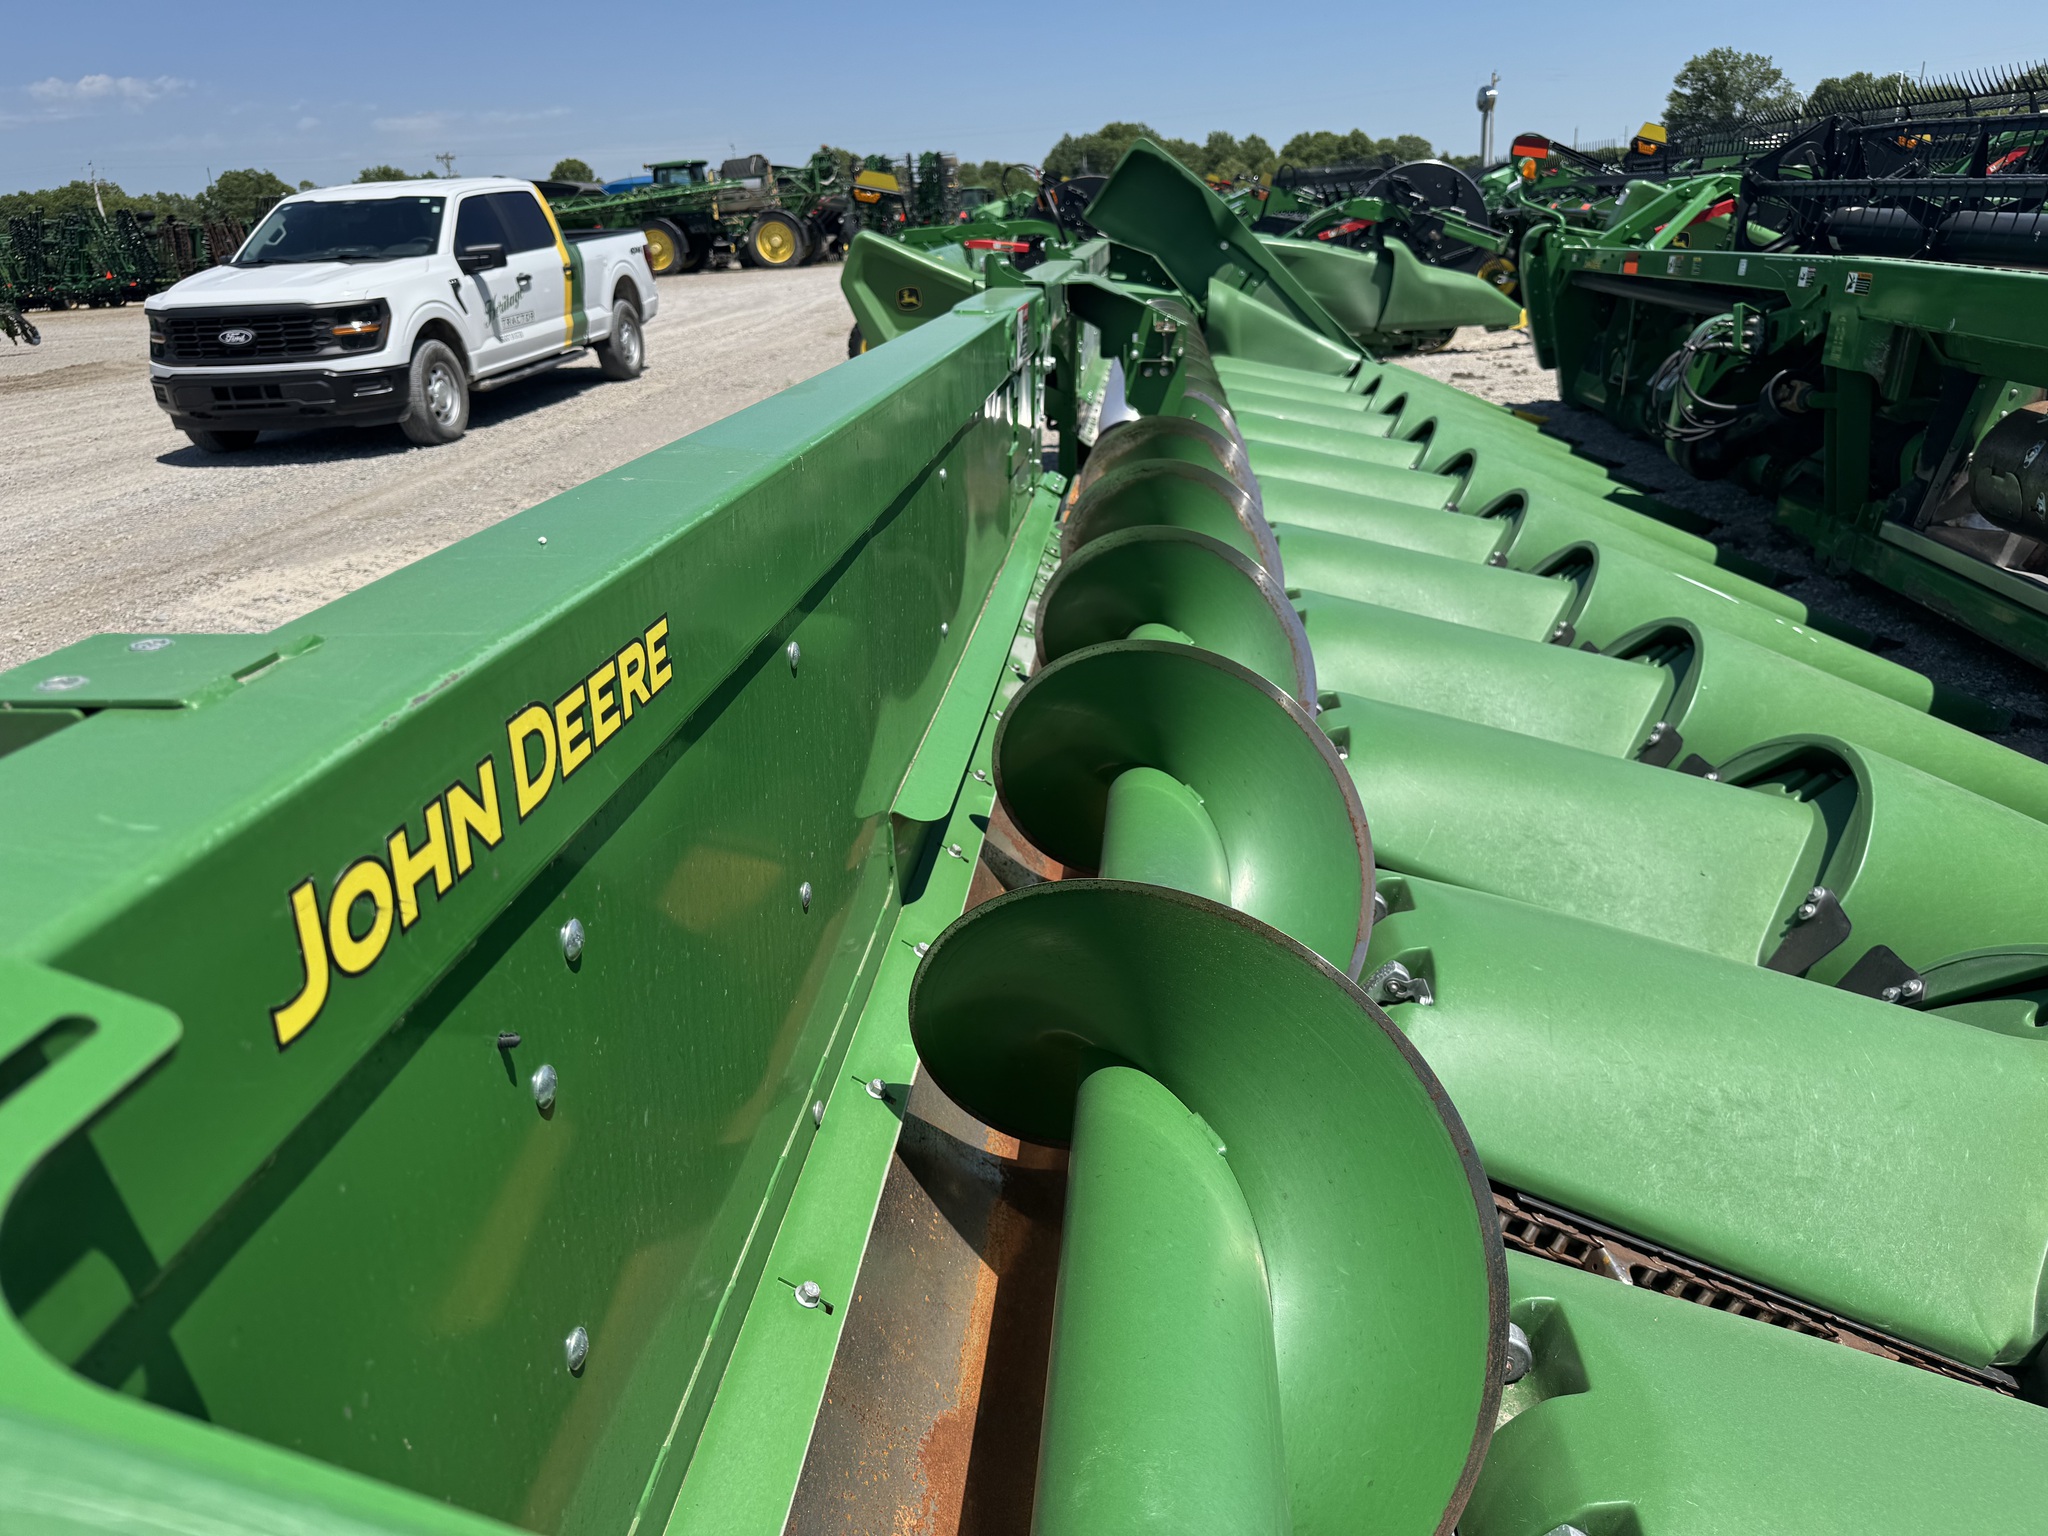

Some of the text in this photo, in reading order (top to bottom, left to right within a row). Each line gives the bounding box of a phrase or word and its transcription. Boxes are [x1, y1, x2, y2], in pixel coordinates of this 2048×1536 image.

[501, 312, 535, 327] TRACTOR
[269, 613, 673, 1052] JOHN DEERE
